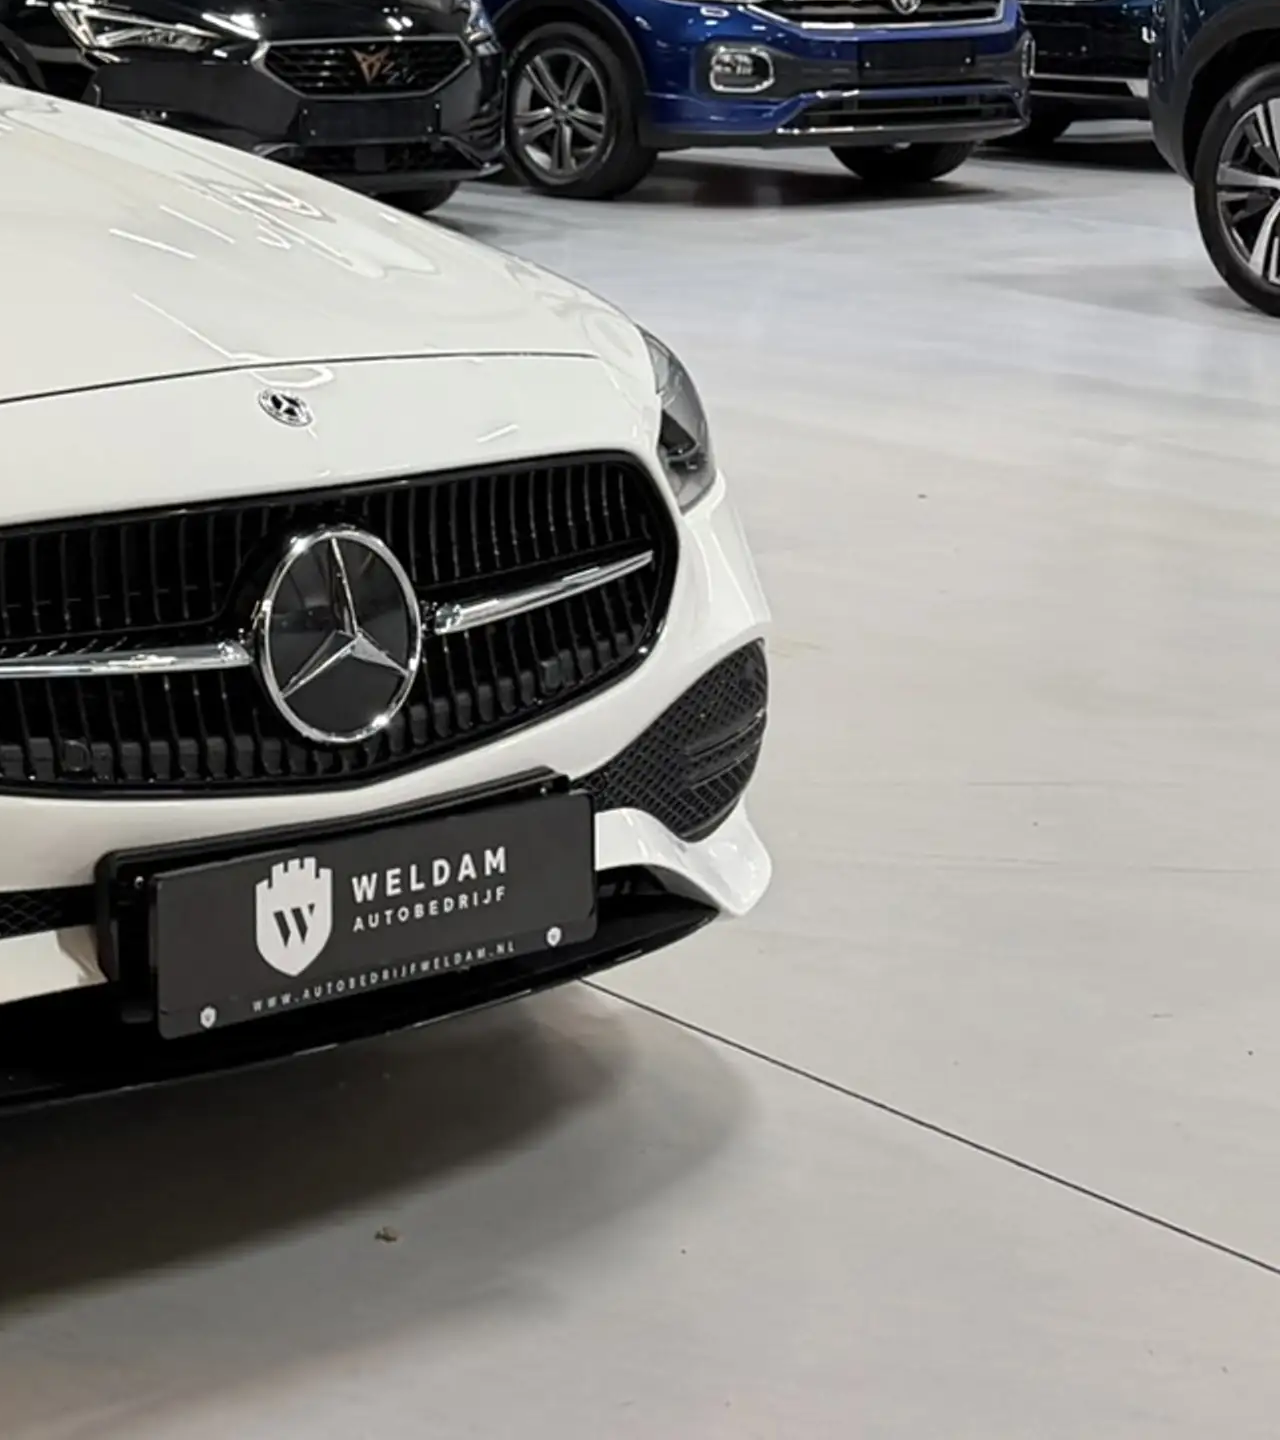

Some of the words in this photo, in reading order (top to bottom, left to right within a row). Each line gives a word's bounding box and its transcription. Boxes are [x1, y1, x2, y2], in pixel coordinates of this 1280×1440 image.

[351, 846, 506, 904] WELDAM
[272, 902, 316, 948] W
[352, 886, 506, 933] AUTOBEDRIJF
[252, 940, 516, 1013] WWW.AUTOBEDRIJFWELDAM.NL
